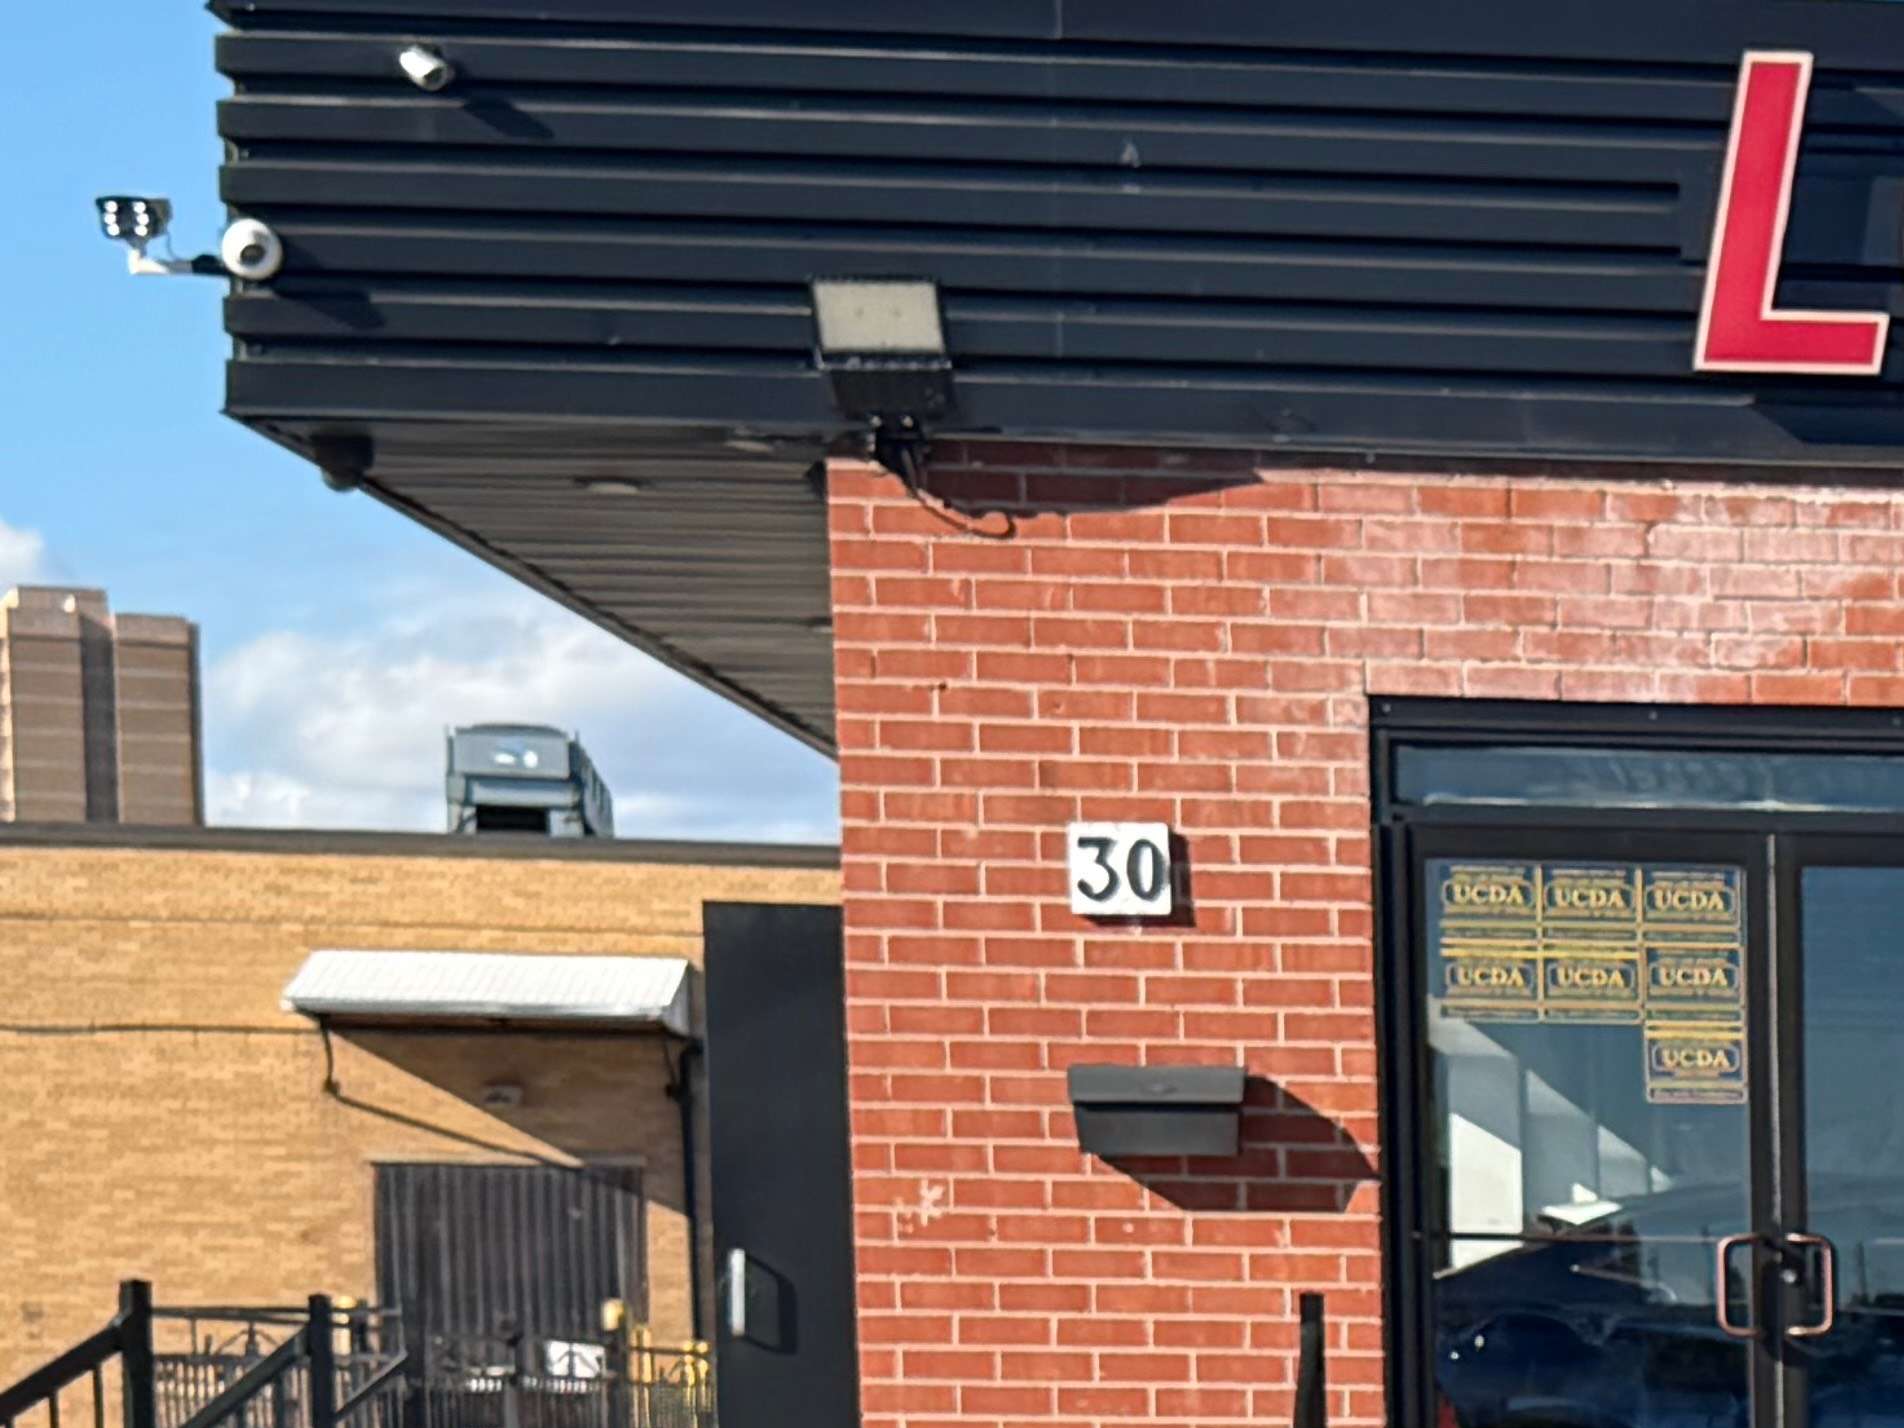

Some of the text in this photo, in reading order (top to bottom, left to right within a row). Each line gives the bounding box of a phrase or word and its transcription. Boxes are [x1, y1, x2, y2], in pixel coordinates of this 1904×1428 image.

[1077, 836, 1165, 902] 30
[1453, 882, 1524, 906] UCDA
[1554, 886, 1624, 908] UCDA
[1655, 889, 1724, 911] UCDA
[1457, 964, 1525, 987] UCDA
[1557, 966, 1625, 988] UCDA
[1658, 966, 1728, 988] UCDA
[1661, 1047, 1730, 1069] UCDA
